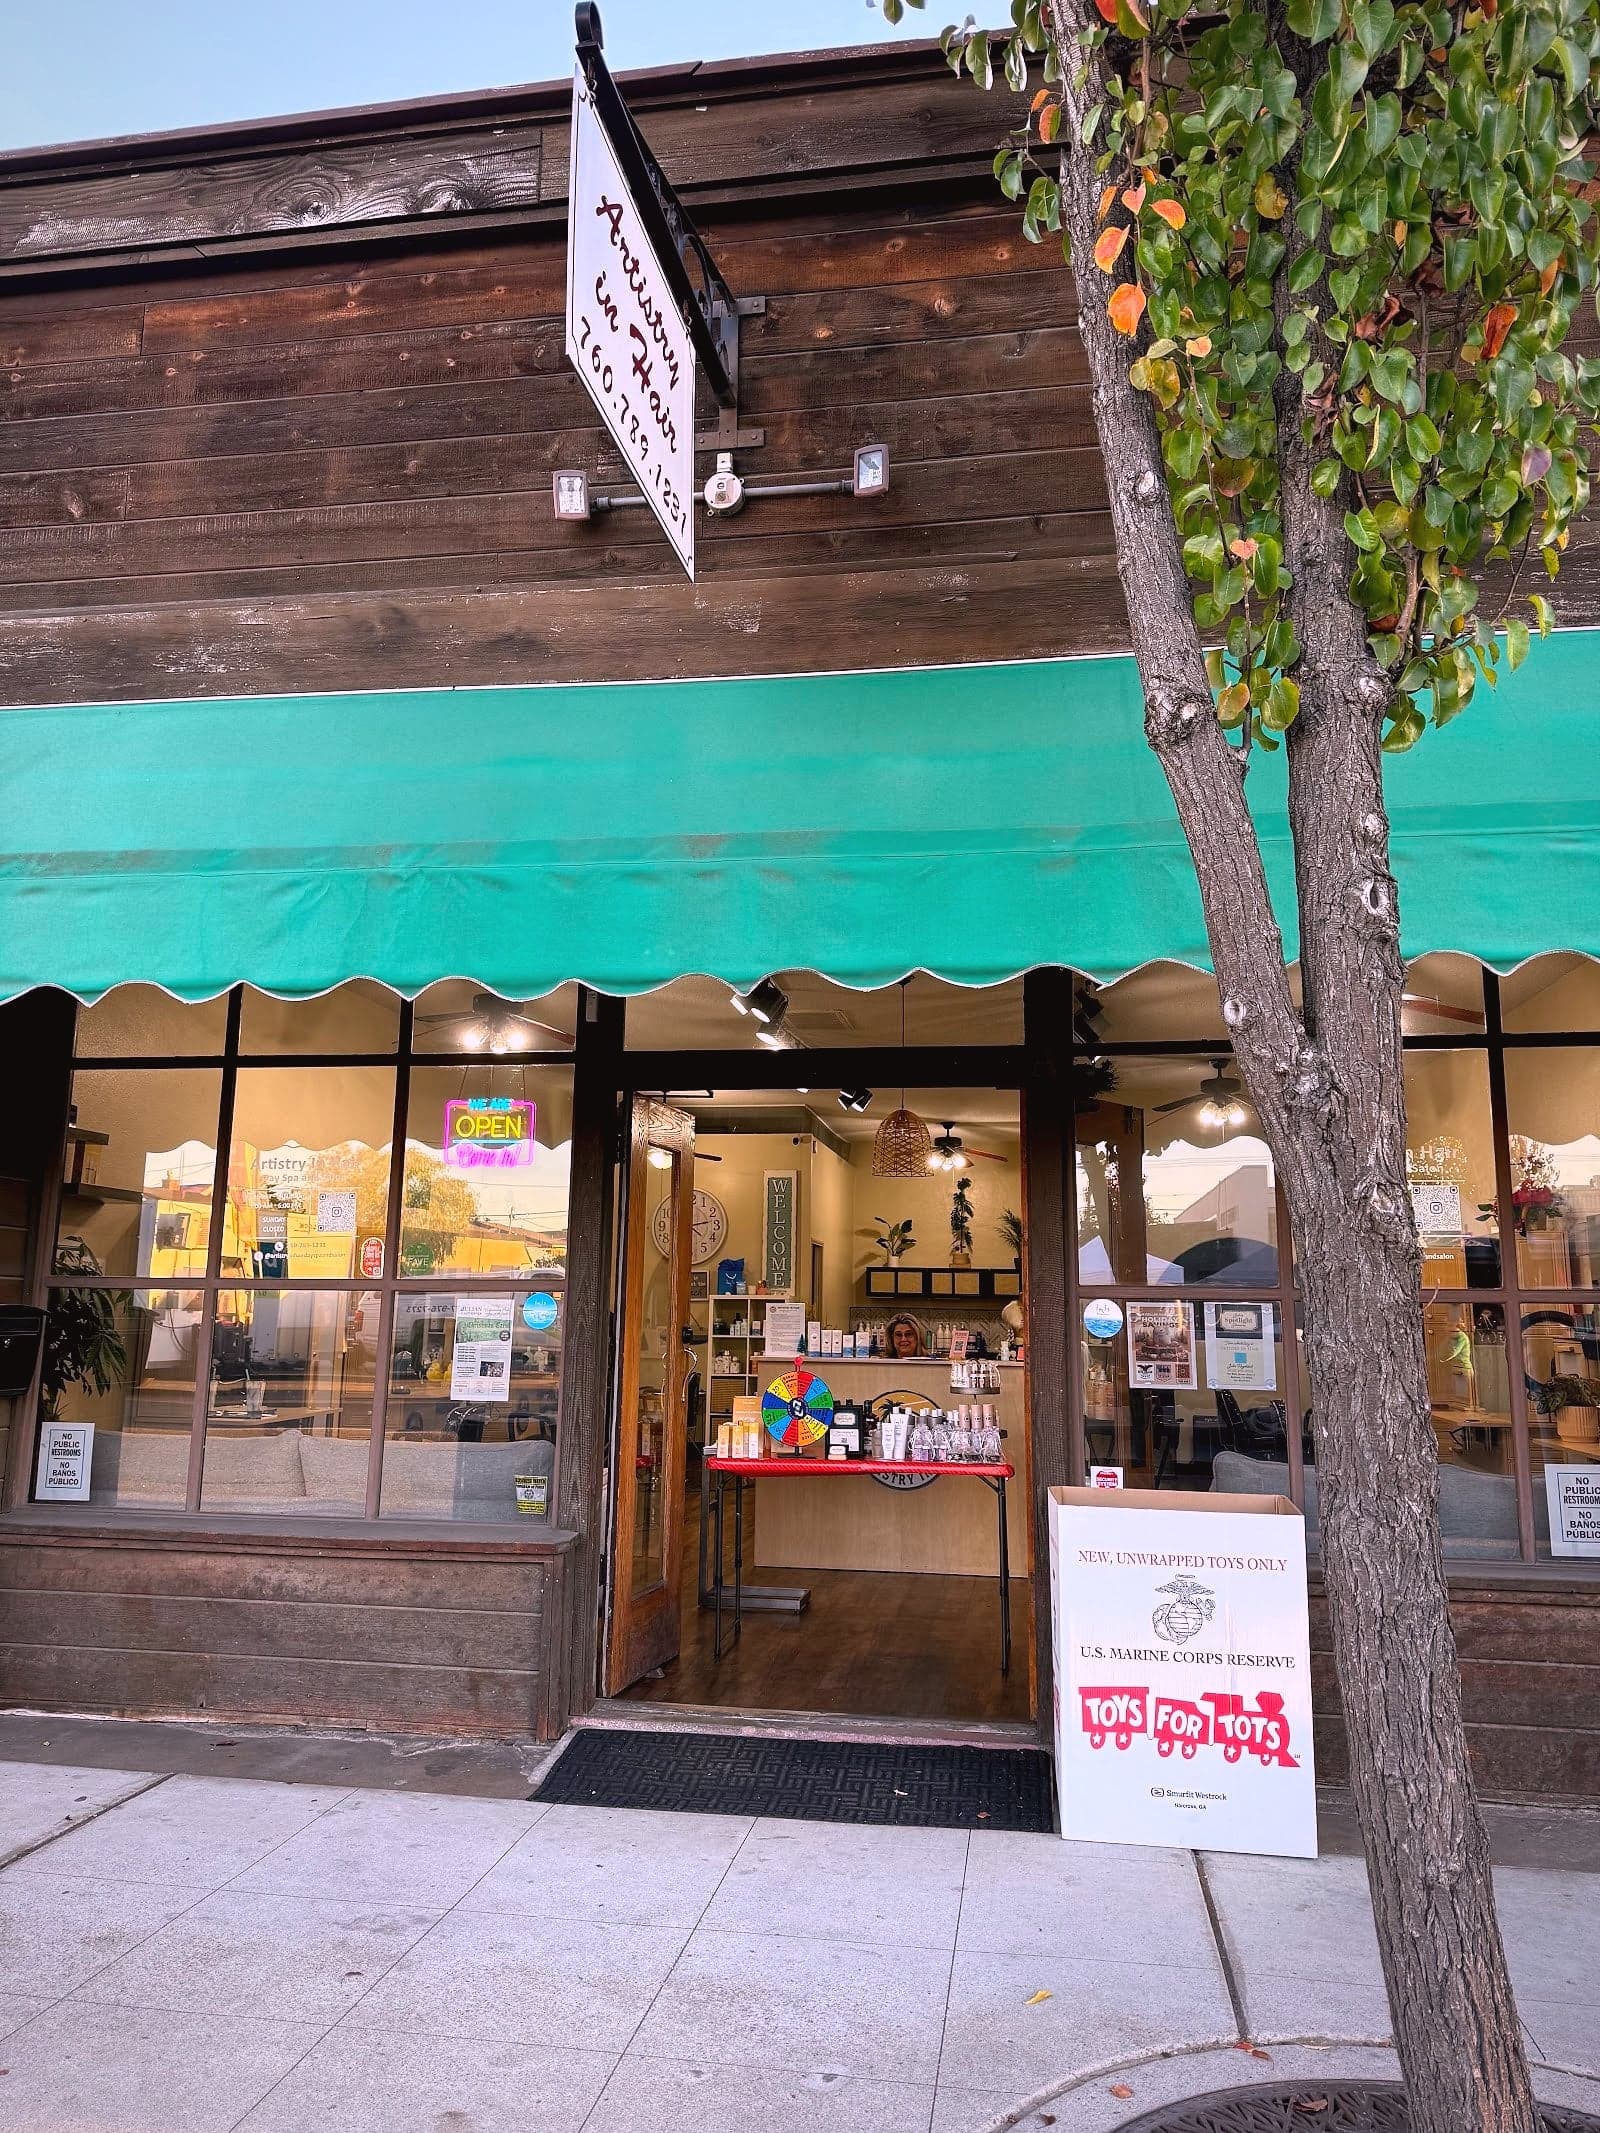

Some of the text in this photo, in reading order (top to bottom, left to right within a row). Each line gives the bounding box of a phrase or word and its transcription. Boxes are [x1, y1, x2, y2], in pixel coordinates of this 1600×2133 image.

[596, 195, 679, 391] Artistry
[596, 271, 676, 453] in Hair
[581, 316, 687, 537] 760.789.1231
[468, 1098, 512, 1110] WE ARE
[456, 1115, 521, 1139] OPEN
[457, 1144, 495, 1168] Come
[1420, 1145, 1457, 1160] Hair
[250, 1157, 307, 1171] Artistry
[282, 1174, 299, 1183] Spa
[701, 1197, 707, 1208] 1
[709, 1207, 717, 1218] 2
[658, 1220, 666, 1232] 9
[713, 1219, 721, 1231] 3
[662, 1232, 669, 1244] 8
[709, 1232, 716, 1243] 4
[771, 1178, 789, 1288] WELCOME
[700, 1242, 708, 1254] 5
[53, 1440, 80, 1448] PUBLIC
[51, 1448, 81, 1457] RESTROOMS
[60, 1461, 70, 1469] NO
[1575, 1477, 1590, 1485] NO
[1565, 1486, 1600, 1495] PUBLIC
[1563, 1495, 1600, 1505] RESTROOM
[1578, 1511, 1592, 1519] NO
[1078, 1550, 1288, 1572] NEW, UNWRAPPED TOYS ONLY
[1080, 1646, 1296, 1669] U.S. MARINE CORPS RESERVE
[1085, 1694, 1281, 1750] TOYS FOR TOTS
[1166, 1789, 1227, 1801] Smurfit Westrock
